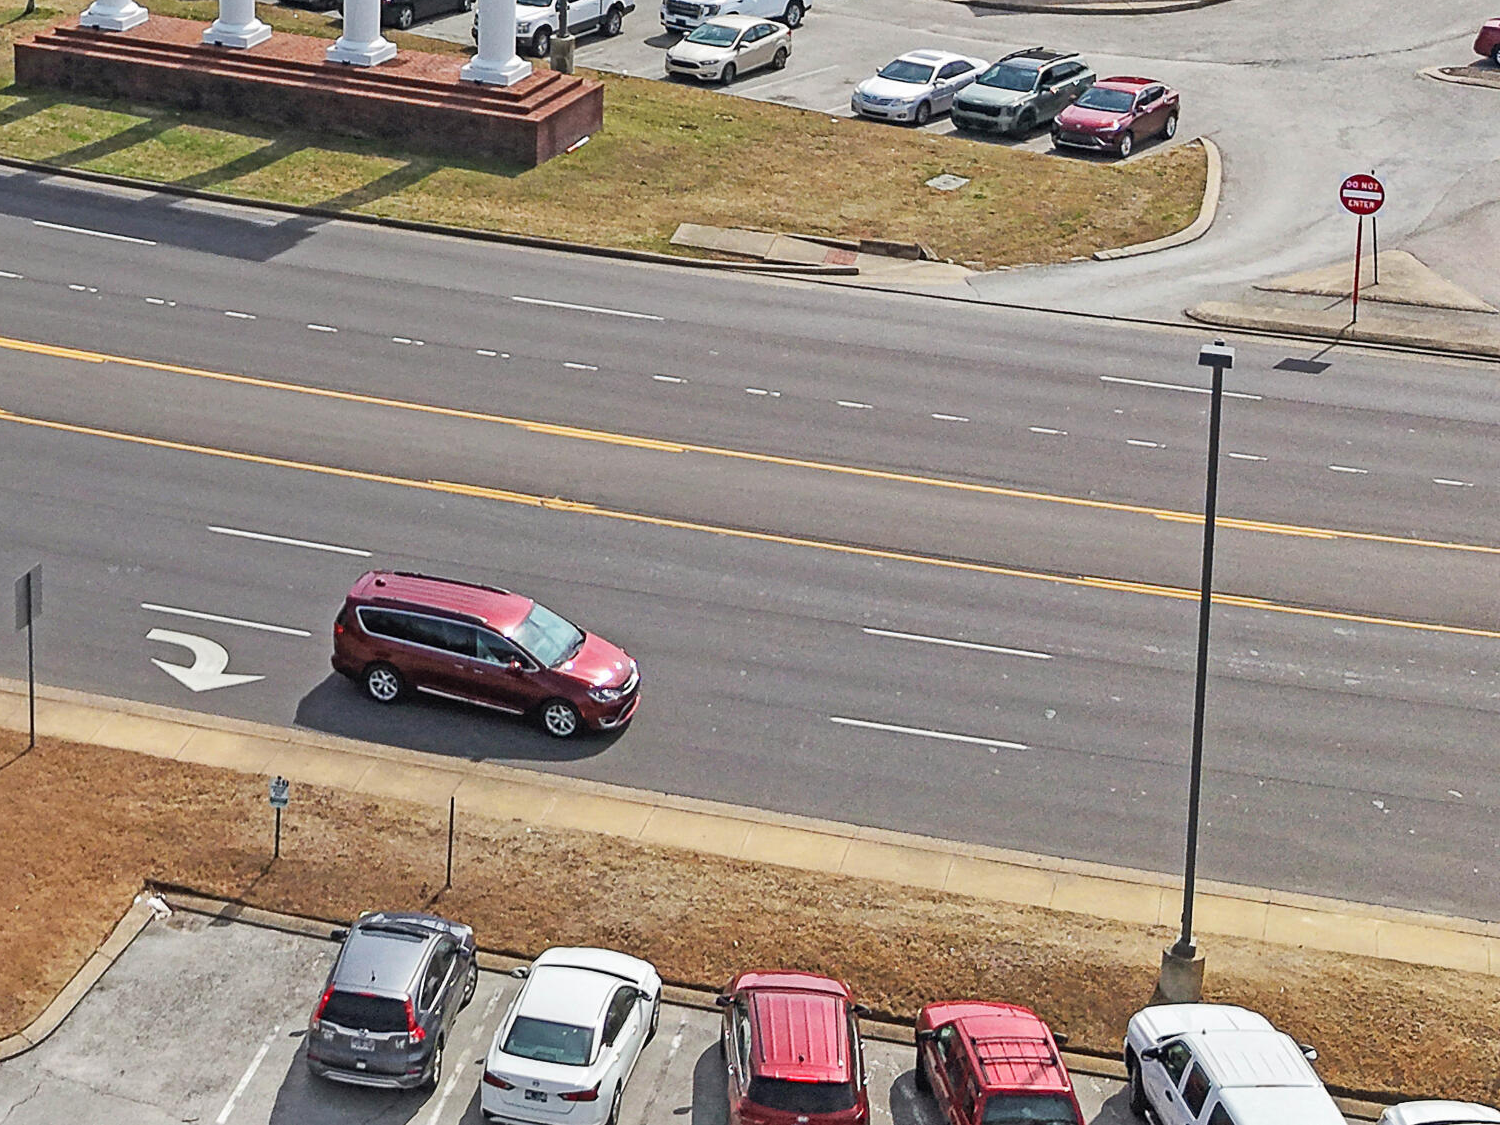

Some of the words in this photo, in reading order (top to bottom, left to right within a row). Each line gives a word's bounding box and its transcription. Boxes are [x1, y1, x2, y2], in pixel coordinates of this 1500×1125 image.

[1346, 180, 1359, 188] DO
[1361, 182, 1379, 190] NOT
[1348, 199, 1375, 209] ENTER
